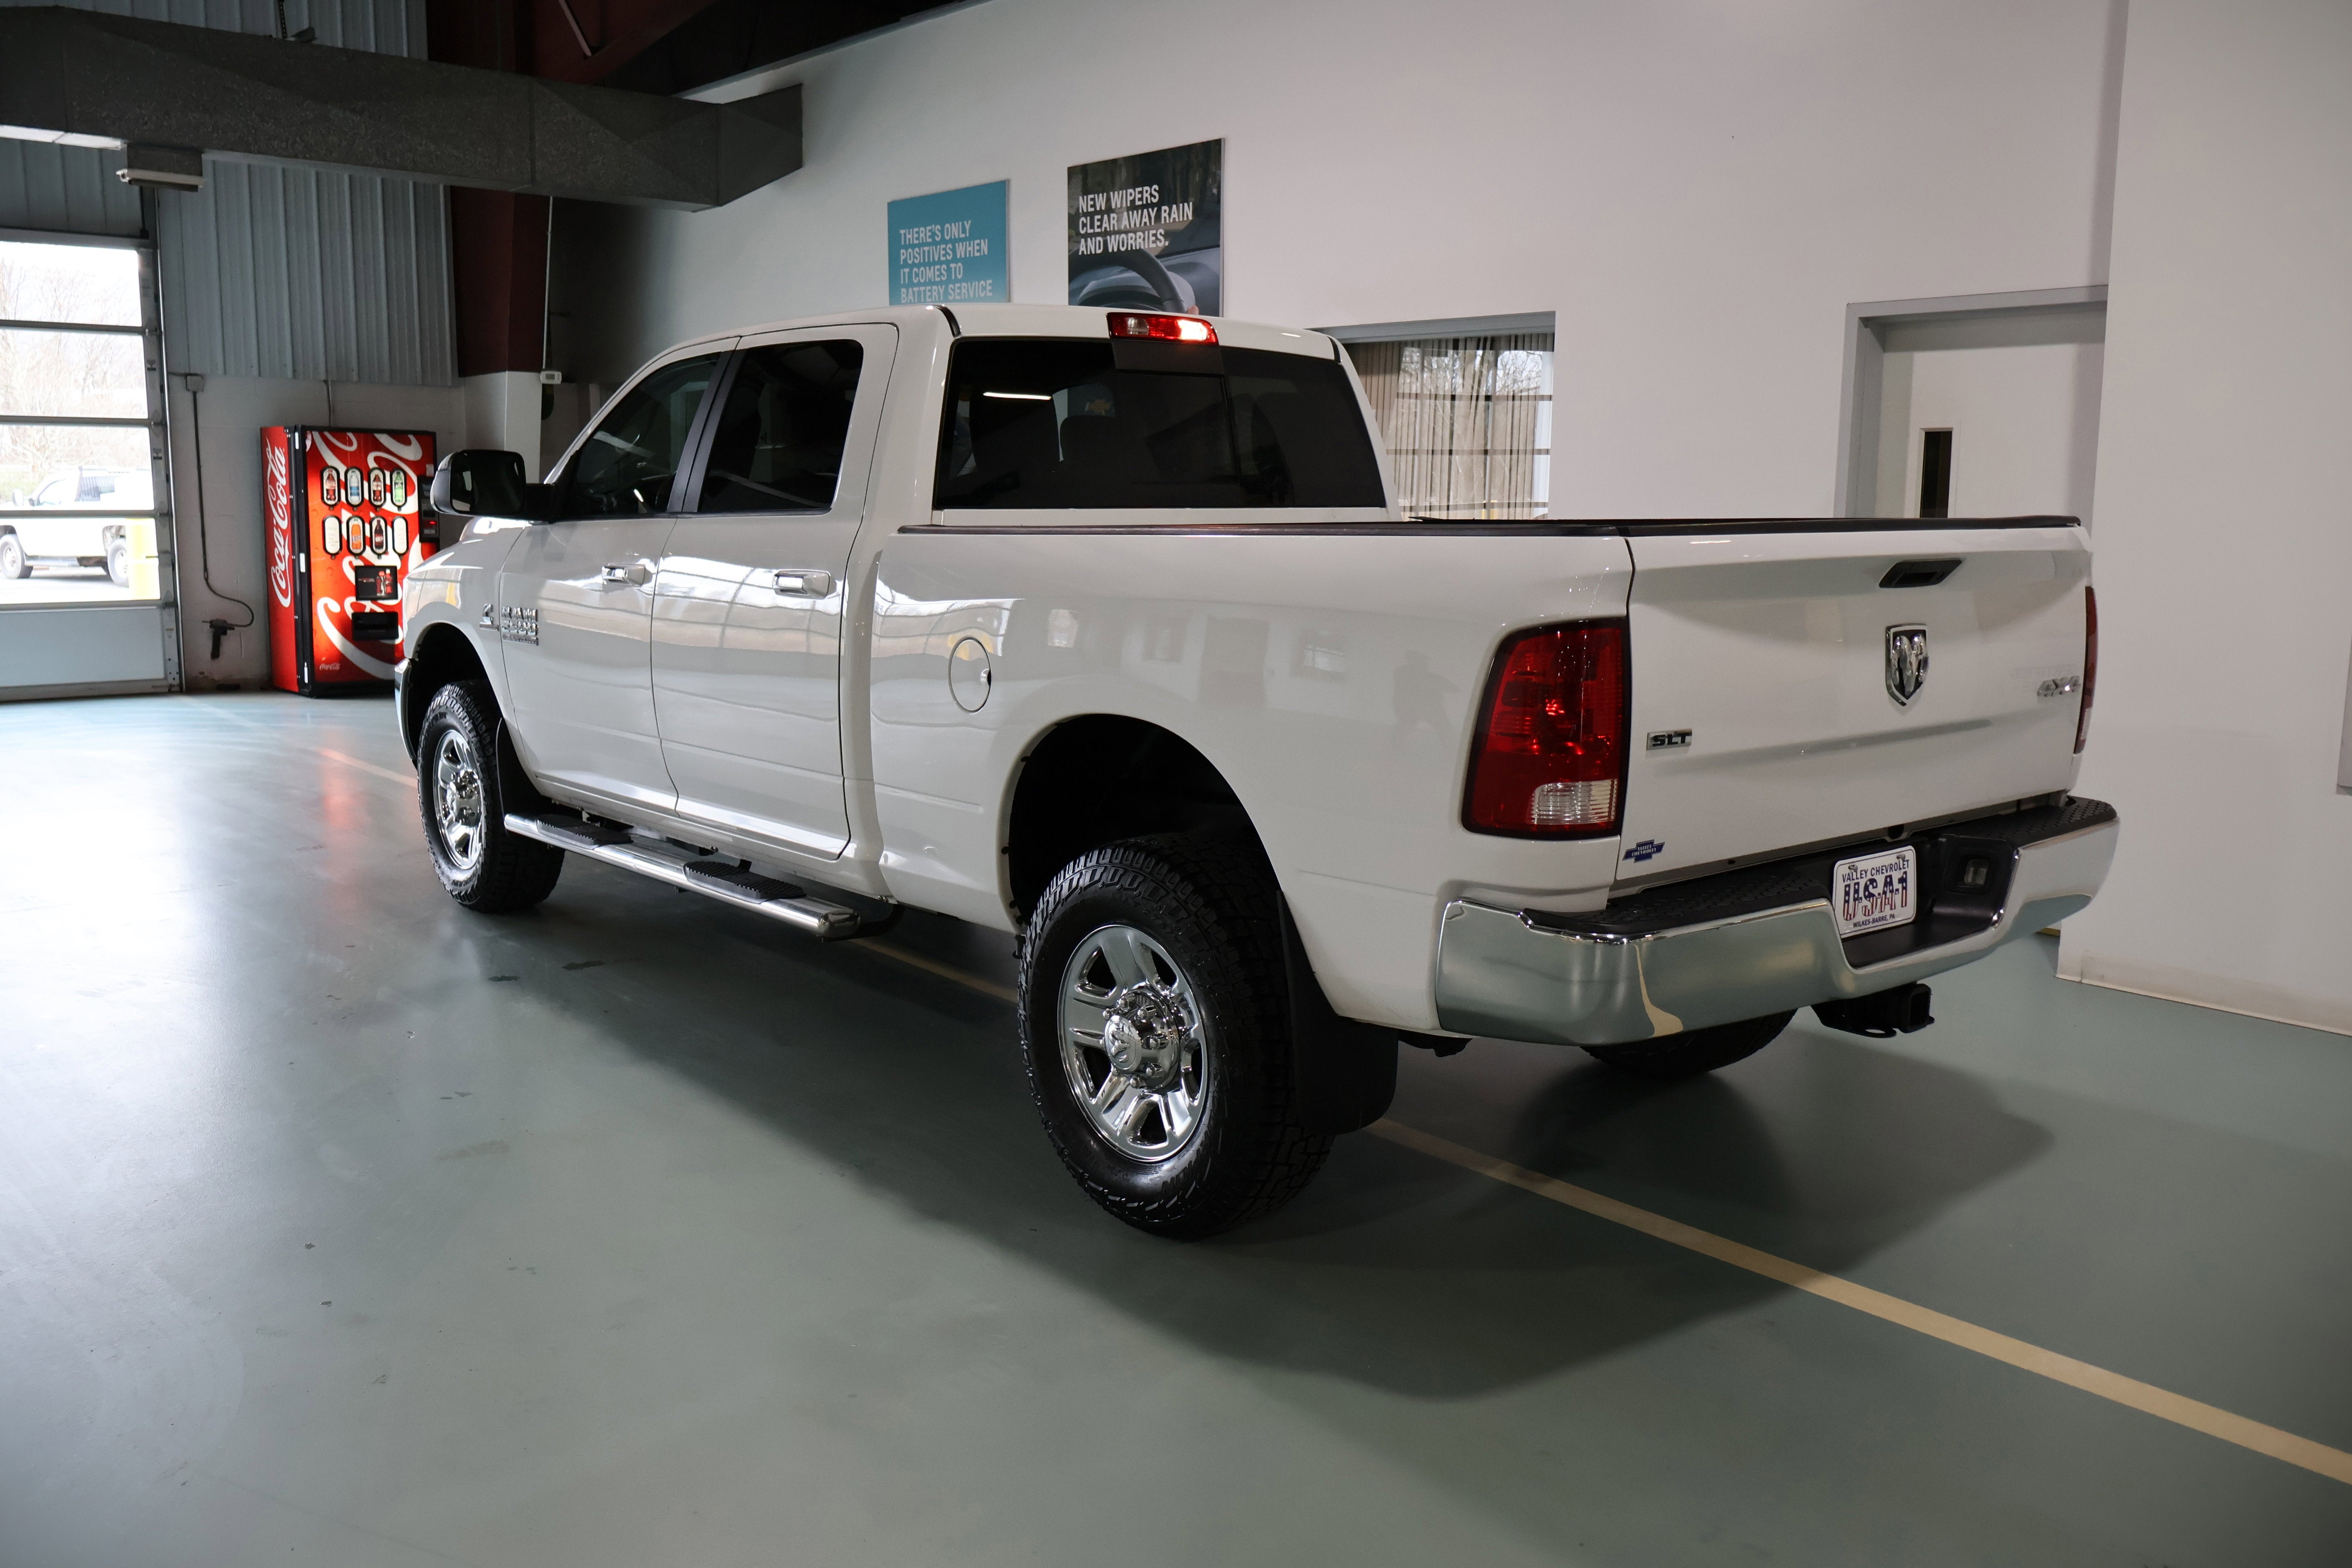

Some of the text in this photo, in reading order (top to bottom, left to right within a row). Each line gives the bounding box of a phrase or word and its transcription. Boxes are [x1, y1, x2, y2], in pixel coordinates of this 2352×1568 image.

[1079, 185, 1159, 213] NEW WIPERS
[1079, 202, 1193, 234] CLEAR AWAY RAIN
[900, 220, 971, 245] THERE'S ONLY
[1079, 228, 1169, 256] AND WORRIES.
[900, 239, 988, 265] POSITIVES WHEN
[900, 263, 963, 284] IT COMES TO
[901, 280, 993, 303] BATTERY SERVICE
[1650, 731, 1693, 747] SLT
[1842, 869, 1869, 883] VALLEY
[1870, 859, 1910, 877] CHEVROLET
